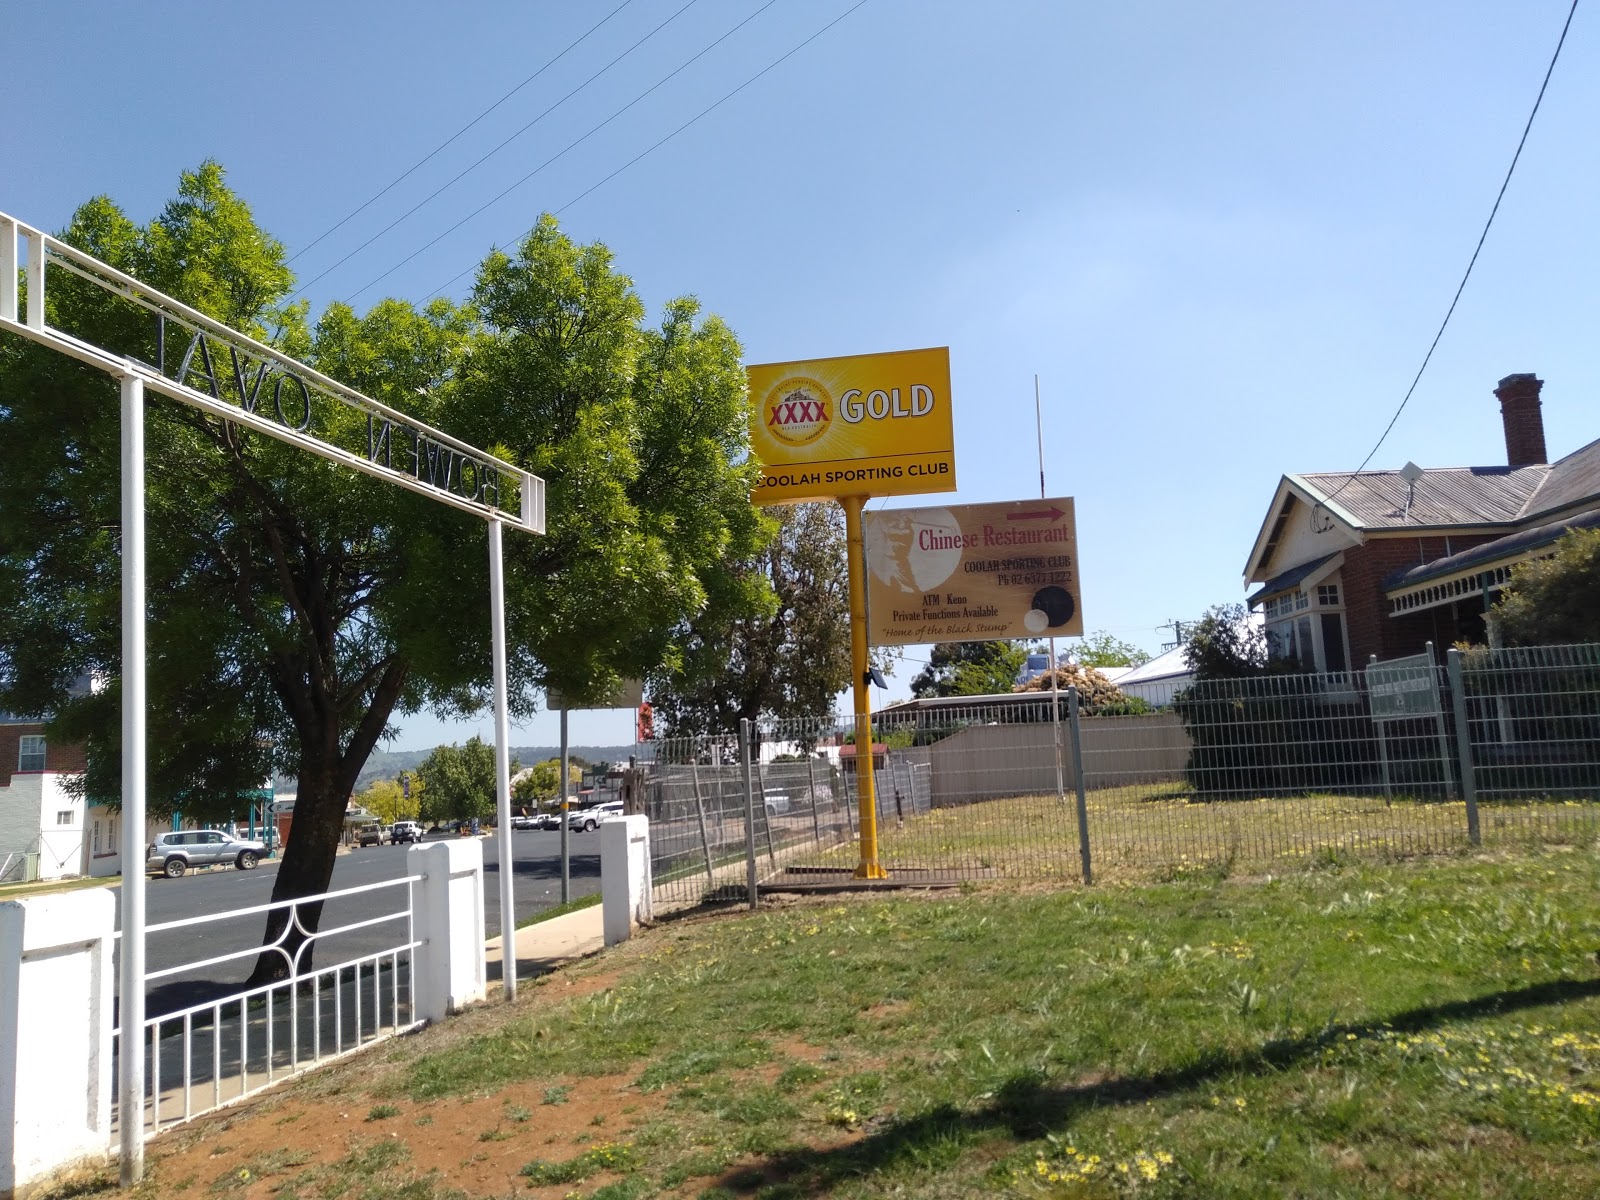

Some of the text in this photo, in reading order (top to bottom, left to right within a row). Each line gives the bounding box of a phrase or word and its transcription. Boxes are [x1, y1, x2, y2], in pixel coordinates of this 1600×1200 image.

[839, 384, 934, 423] GOLD
[768, 402, 830, 426] XXXX
[825, 466, 903, 483] SPORTING
[908, 462, 949, 476] CLUB
[918, 523, 1069, 551] Chinese Restaurant
[964, 555, 1071, 573] COOLAH SPORTING CLUB
[998, 574, 1009, 586] Ph
[1011, 573, 1022, 585] 02
[1050, 570, 1072, 583] 1222
[922, 593, 967, 606] ATM Keno
[893, 605, 999, 622] Private Functions Available
[882, 622, 1013, 641] "Home of the Black Stump"
